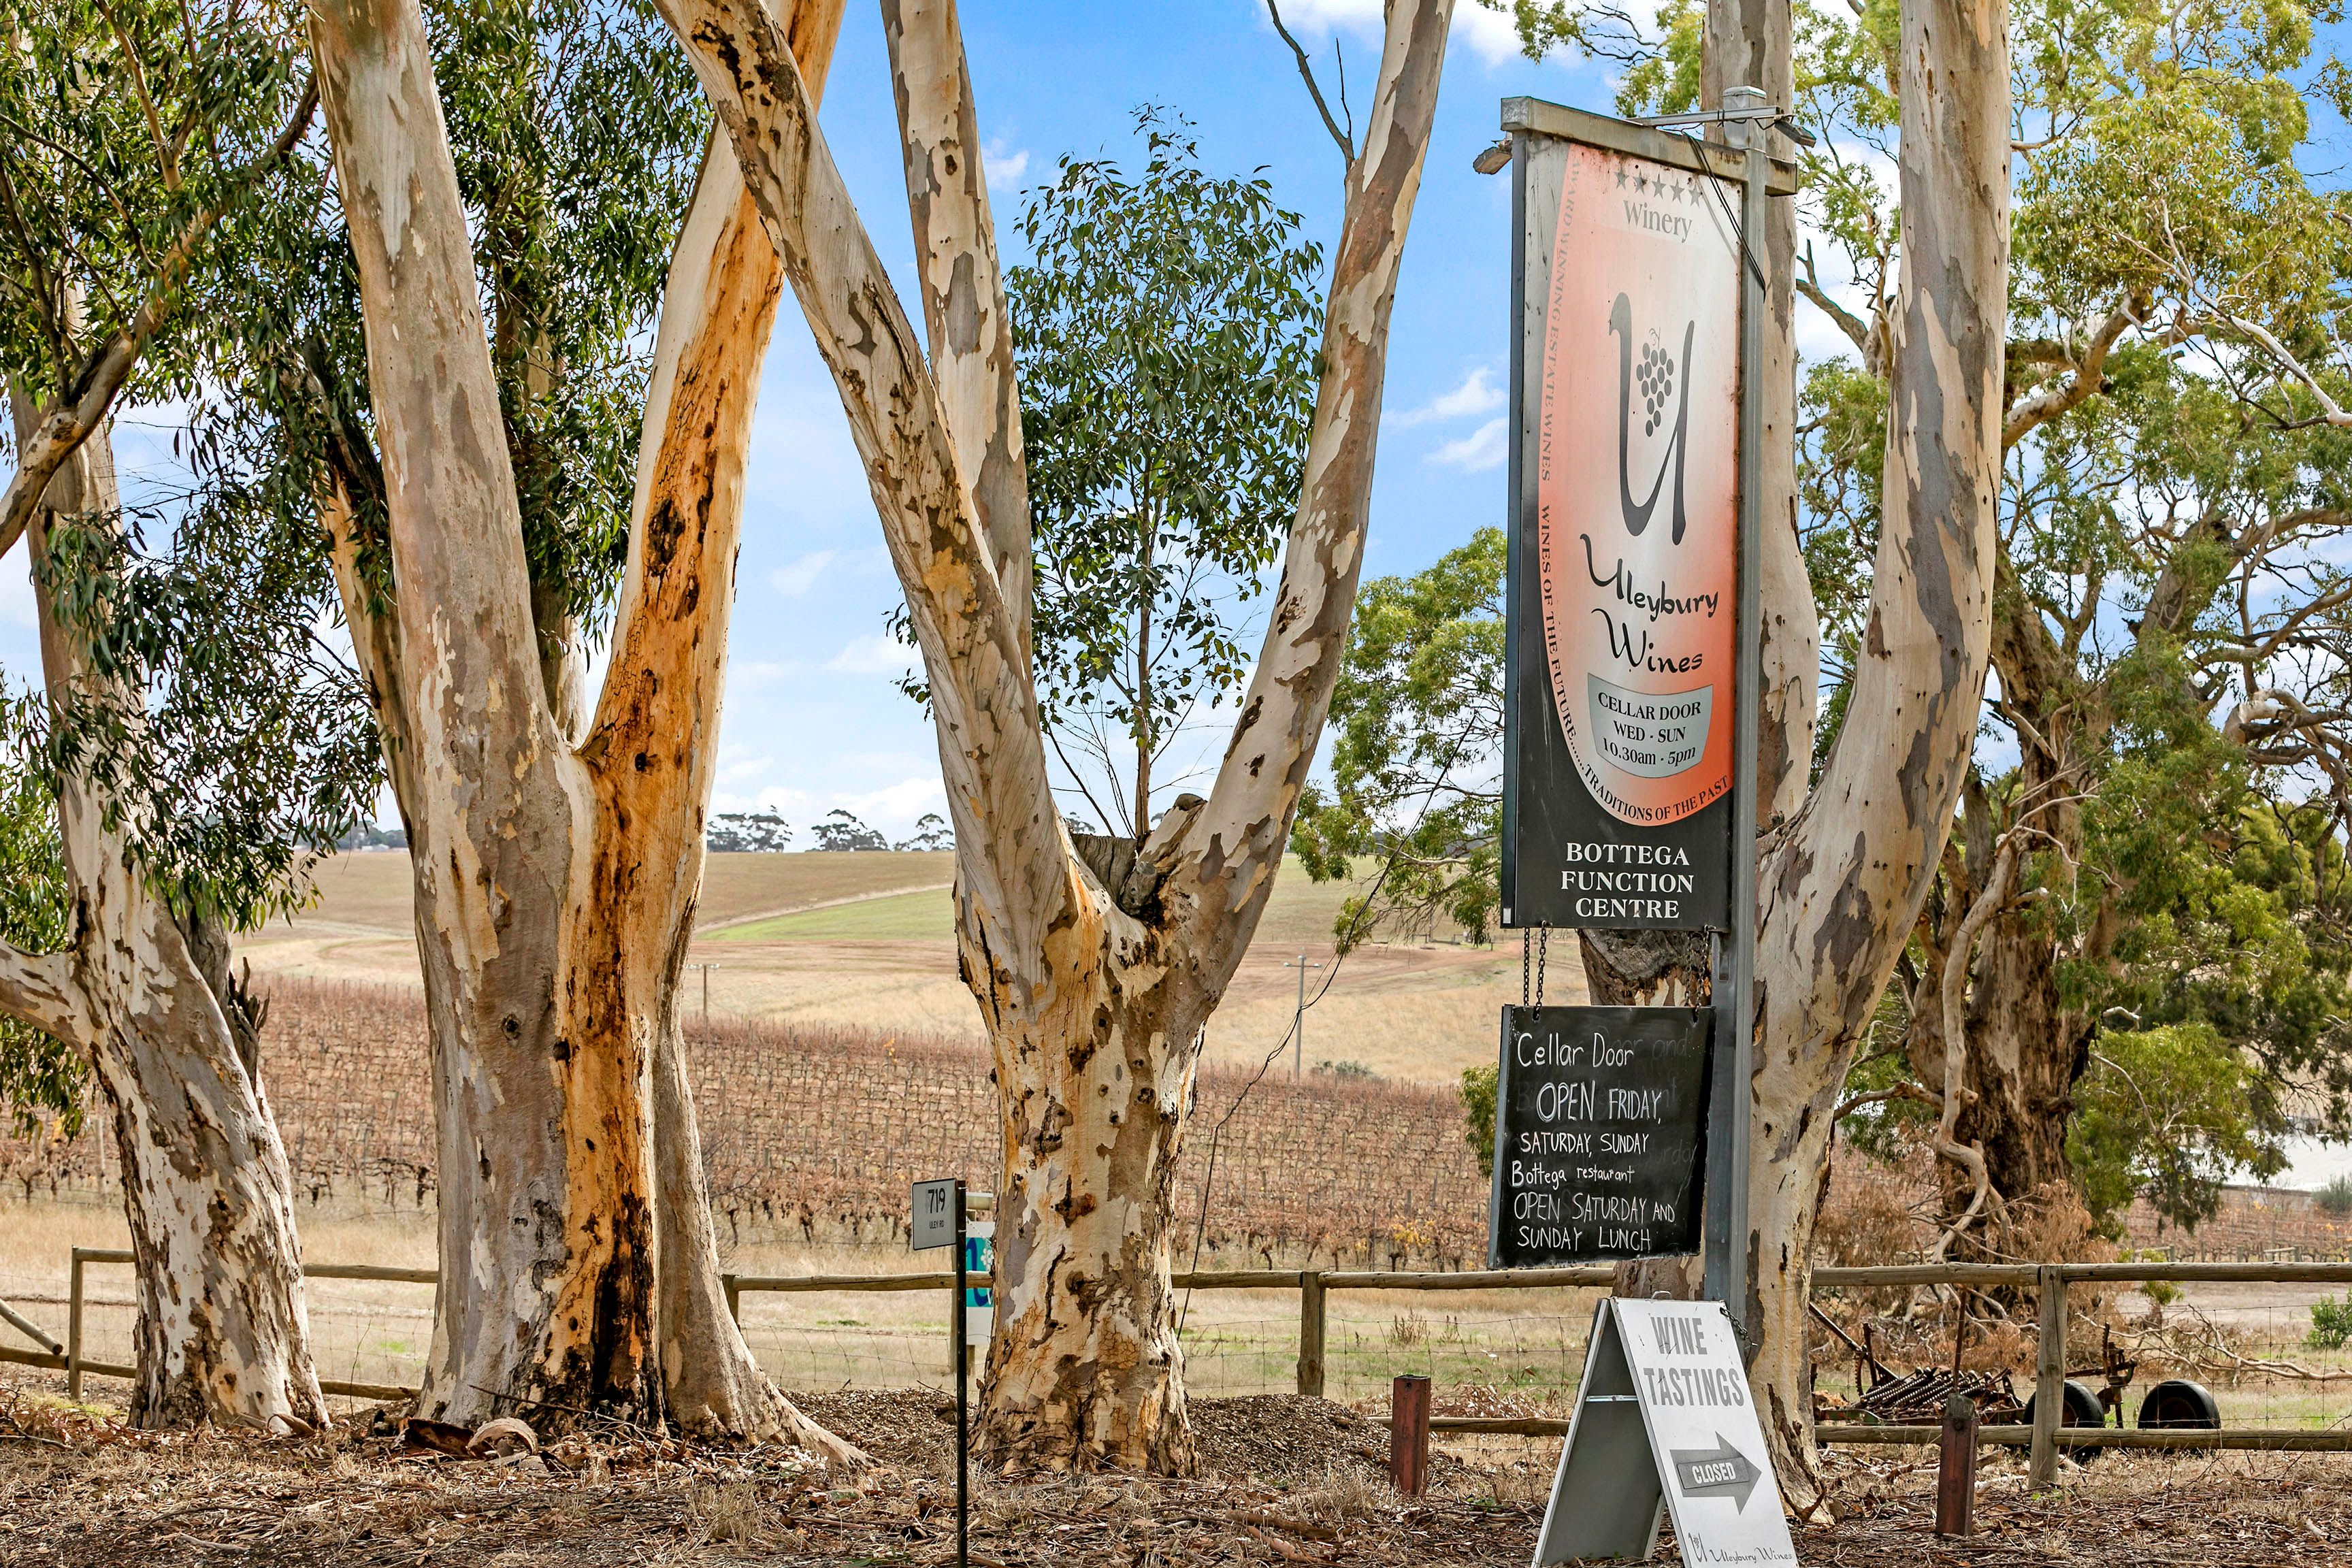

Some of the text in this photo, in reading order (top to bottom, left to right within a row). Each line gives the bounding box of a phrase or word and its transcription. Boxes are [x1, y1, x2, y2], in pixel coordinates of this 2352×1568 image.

[1623, 199, 1693, 243] Winery
[1541, 160, 1580, 481] AWARD WINNING ESTATE WINES
[1541, 505, 1551, 574] WINES
[1543, 578, 1553, 606] OF
[1580, 533, 1718, 622] Uleybury
[1546, 611, 1558, 655] THE
[1590, 608, 1703, 674] Wines
[1598, 691, 1701, 721] CELLAR DOOR
[1613, 720, 1645, 741] WED
[1658, 726, 1686, 743] SUN
[1602, 737, 1656, 765] 10.30am
[1667, 747, 1696, 767] 5pm
[1699, 774, 1729, 805] PAST
[1655, 806, 1671, 821] OF
[1673, 796, 1698, 816] THE
[1566, 842, 1690, 866] BOTTEGA
[1561, 870, 1694, 894] FUNCTION
[1575, 897, 1680, 919] CENTRE
[1517, 1032, 1585, 1068] Cellar
[1592, 1032, 1633, 1068] Door
[1536, 1079, 1596, 1123] OPEN
[1608, 1088, 1663, 1124] FRIDAY,
[1520, 1131, 1592, 1158] SATURDAY,
[1600, 1132, 1650, 1155] SUNDAY
[1512, 1160, 1635, 1190] Bottega restaurant
[928, 1188, 945, 1213] 719
[1514, 1192, 1676, 1224] OPEN SATURDAY AND
[1517, 1226, 1651, 1253] SUNDAY LUNCH
[1650, 1316, 1708, 1355] WINE
[1643, 1367, 1745, 1407] TASTINGS
[1692, 1462, 1737, 1484] CLOSED
[1709, 1549, 1757, 1564] Uleybury
[1754, 1547, 1793, 1561] Wines
